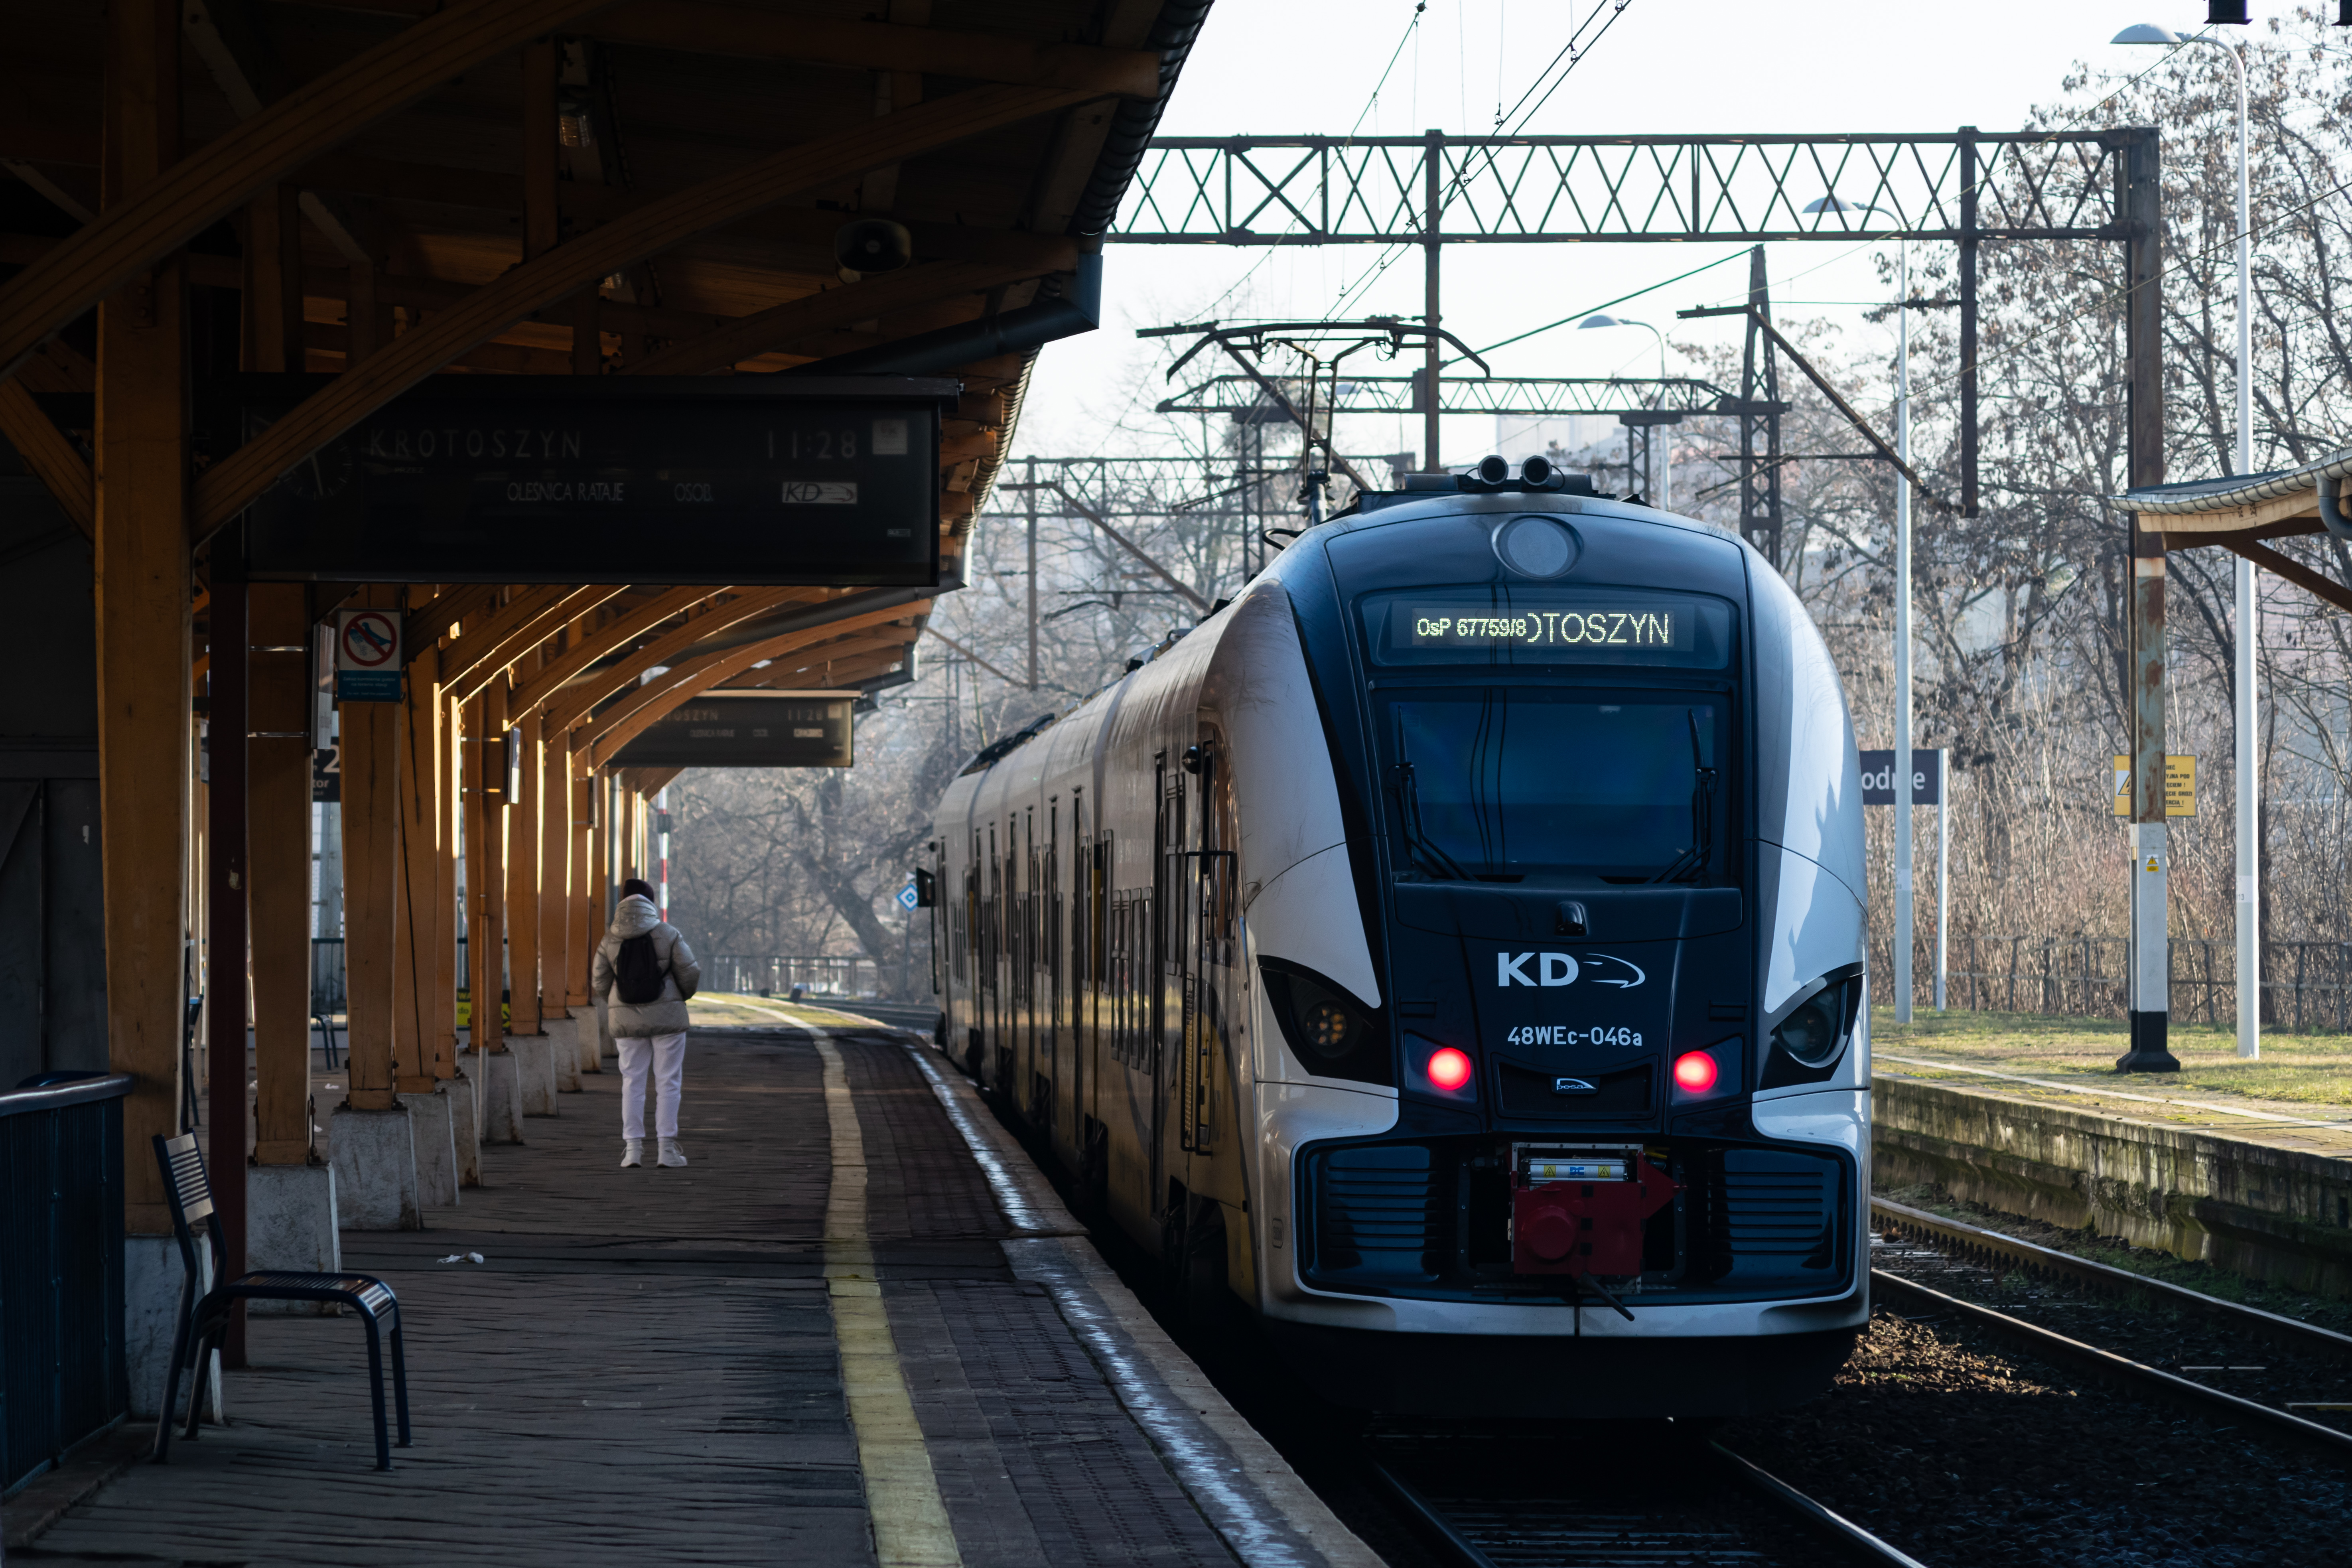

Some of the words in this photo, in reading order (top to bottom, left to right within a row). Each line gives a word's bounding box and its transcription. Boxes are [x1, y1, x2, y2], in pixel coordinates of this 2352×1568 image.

[370, 428, 582, 458] KROTOSZYN
[768, 430, 857, 460] 11:28
[507, 481, 572, 501] OLEŚNICA
[578, 482, 624, 501] RATAJE
[785, 483, 821, 503] KD
[1417, 617, 1451, 636] OsP
[1457, 617, 1526, 637] 67759/8
[323, 744, 339, 773] 2
[1498, 952, 1579, 987] KD
[1508, 1026, 1642, 1046] 48WEc-046a
